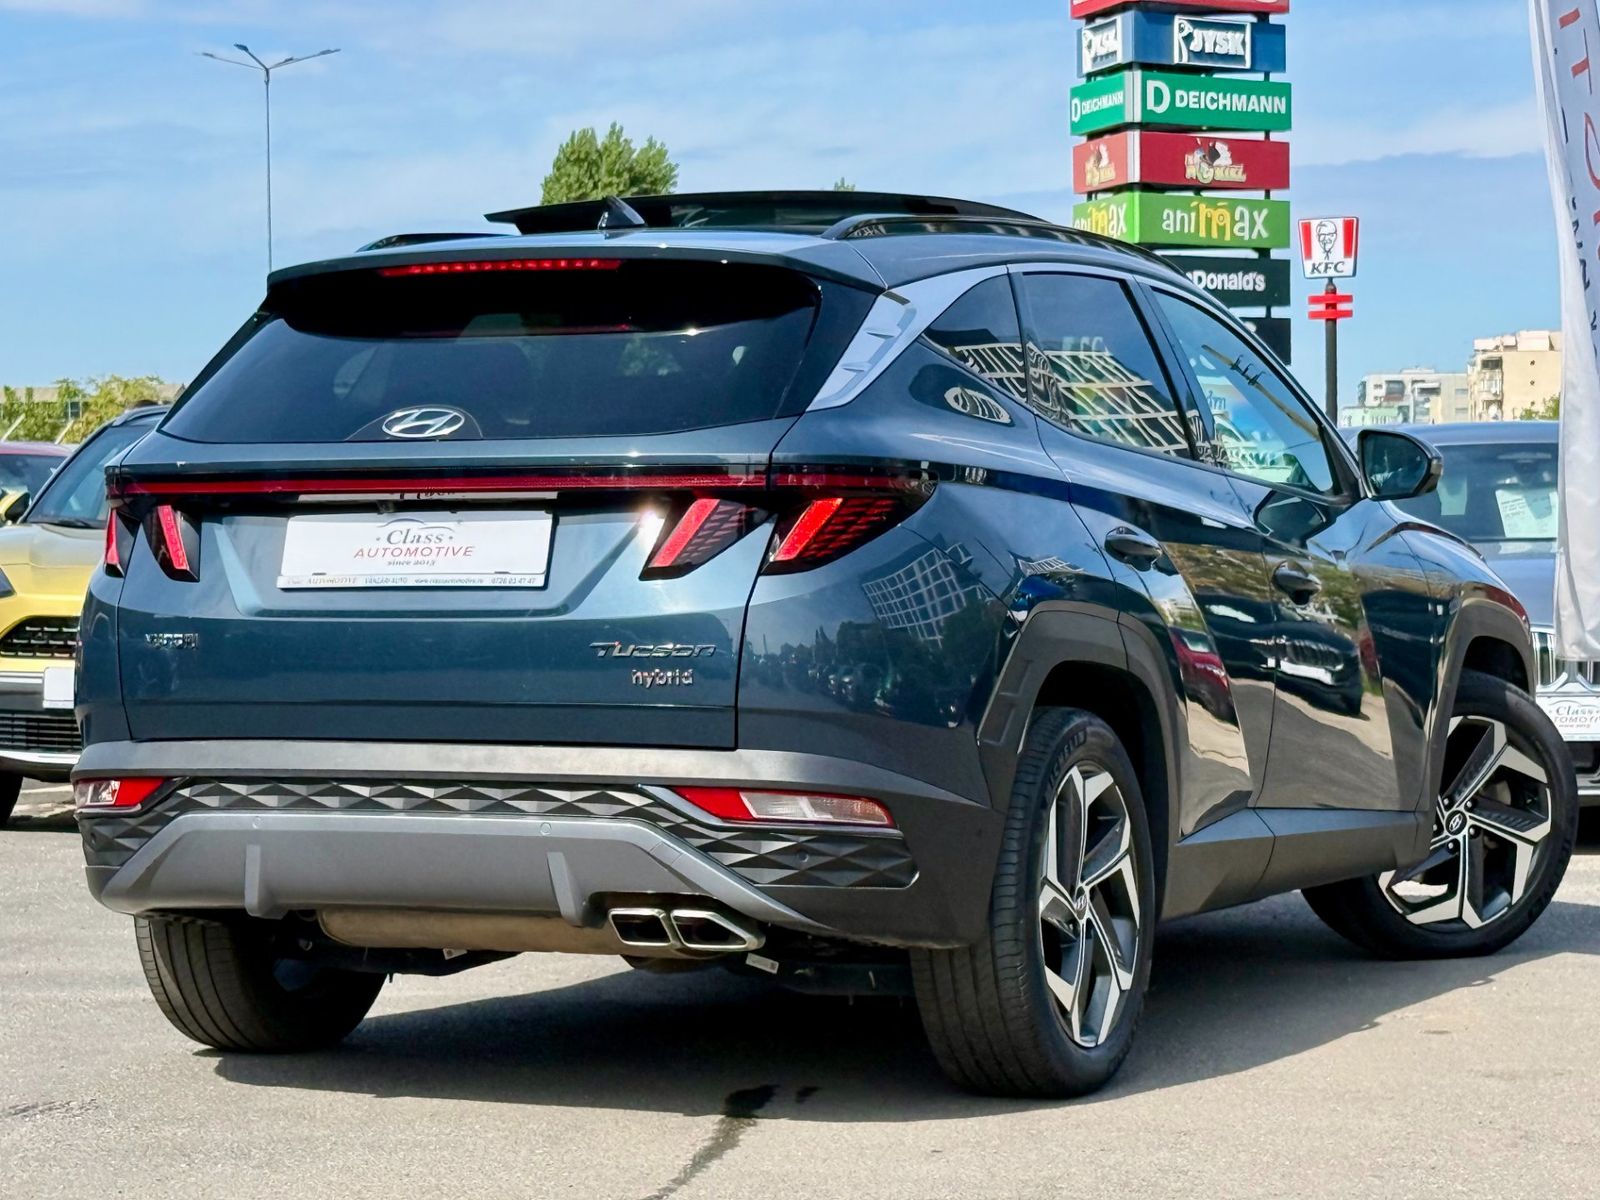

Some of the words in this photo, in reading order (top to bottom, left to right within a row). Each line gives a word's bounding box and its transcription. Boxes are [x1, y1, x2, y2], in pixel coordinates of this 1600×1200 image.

[1189, 28, 1245, 55] JYSK
[1081, 91, 1124, 115] DEICHMANN
[1175, 90, 1287, 114] DEICHMANN
[1162, 201, 1270, 242] animax
[1310, 261, 1345, 275] KFC
[386, 529, 444, 545] Class
[353, 545, 476, 559] AUTOMOTIVE
[631, 668, 693, 688] hybrid
